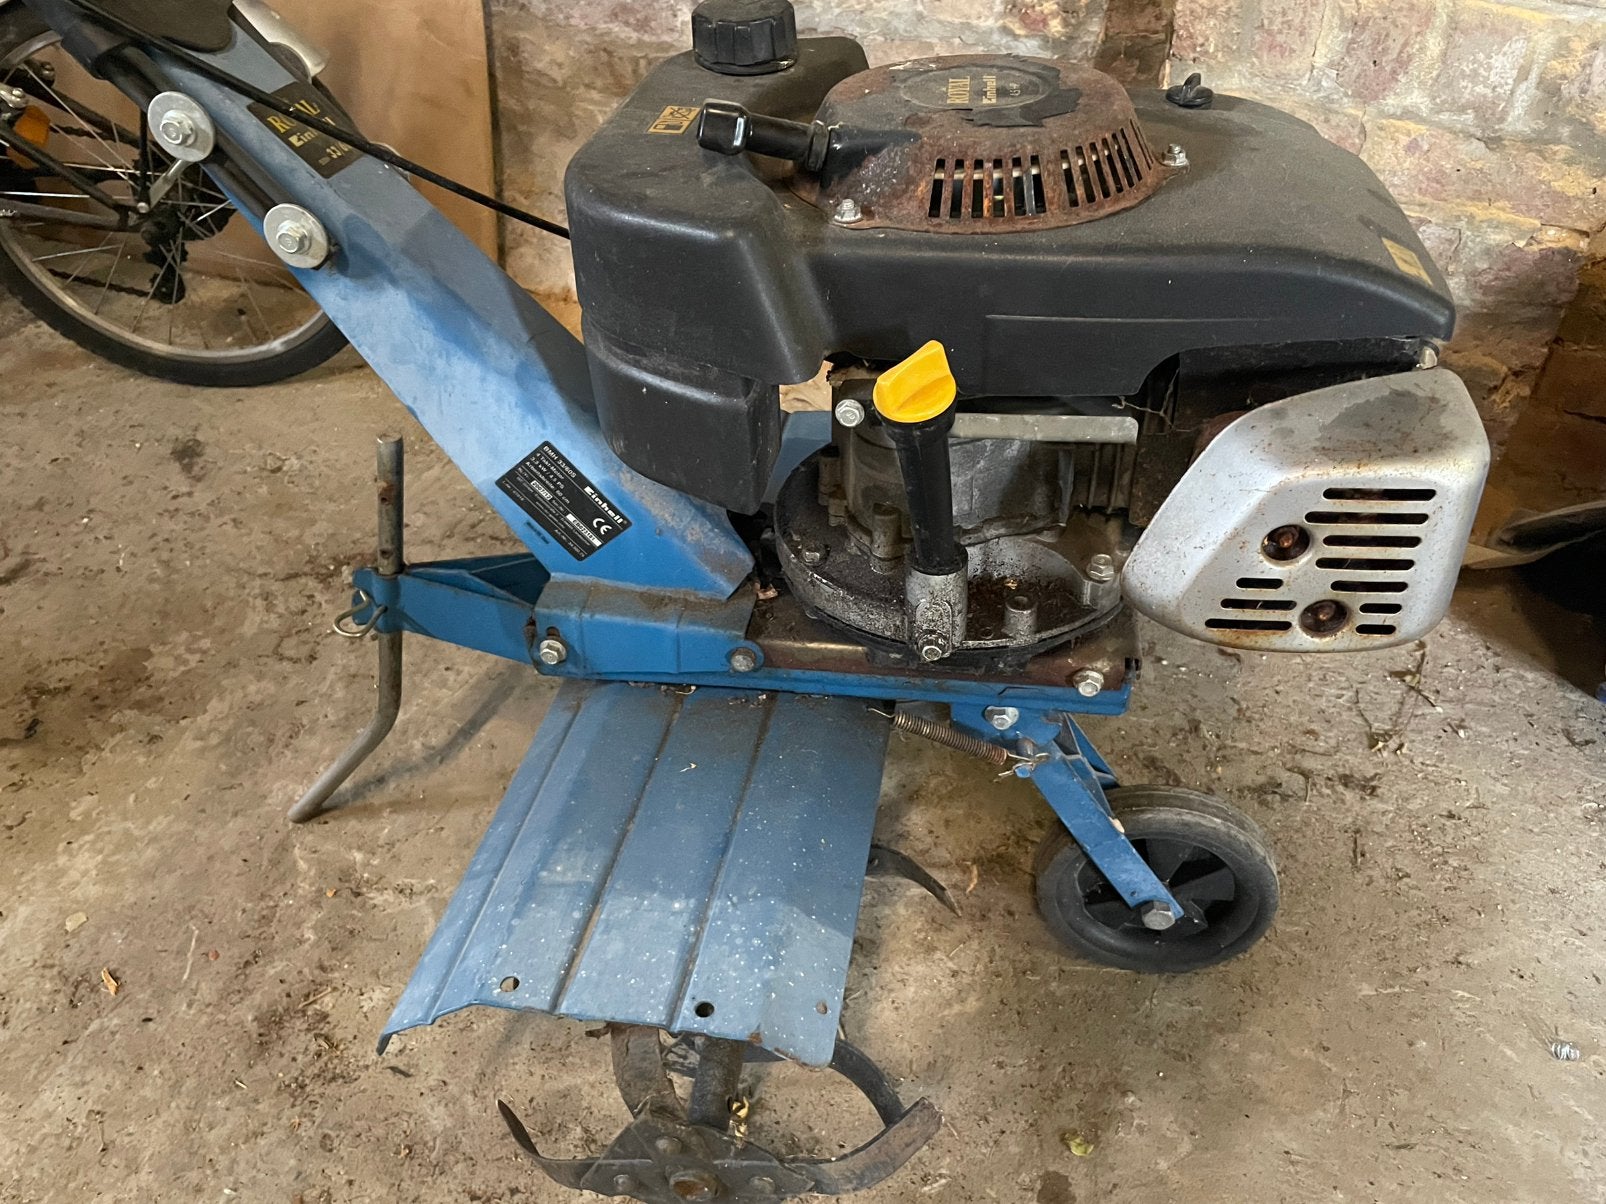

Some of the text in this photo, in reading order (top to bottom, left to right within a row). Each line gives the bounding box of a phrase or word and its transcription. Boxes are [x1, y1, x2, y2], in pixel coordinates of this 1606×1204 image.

[946, 75, 970, 104] ROYAL
[543, 446, 558, 460] BMH
[556, 481, 565, 489] PS
[584, 486, 623, 523] Einhell
[593, 518, 612, 535] CE
